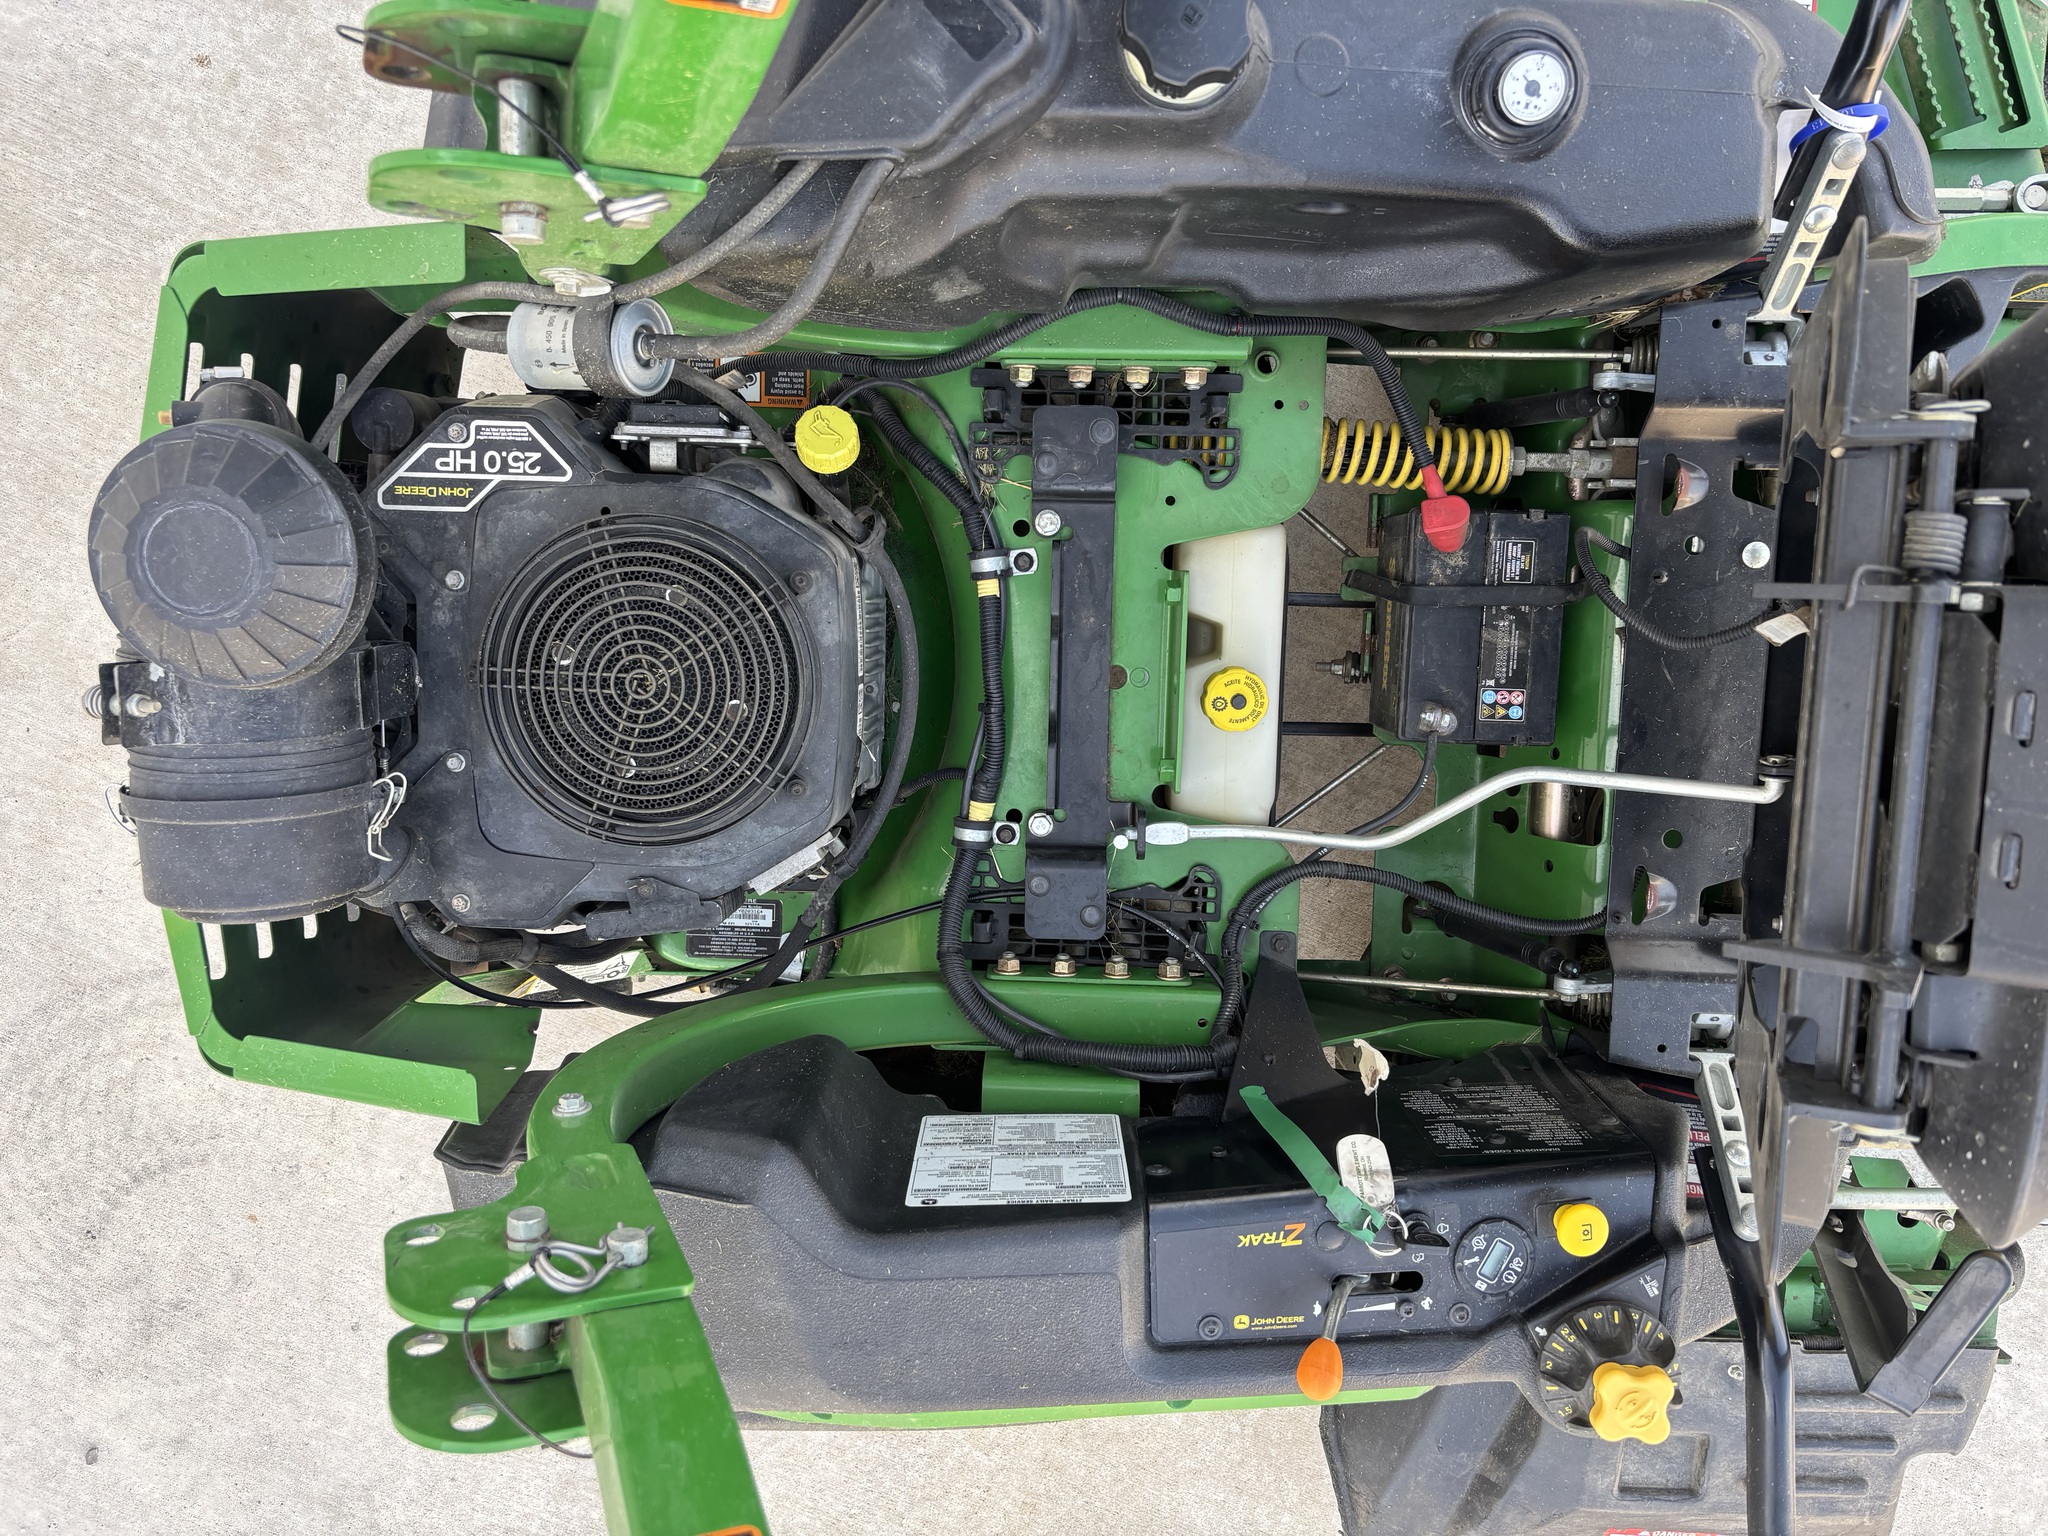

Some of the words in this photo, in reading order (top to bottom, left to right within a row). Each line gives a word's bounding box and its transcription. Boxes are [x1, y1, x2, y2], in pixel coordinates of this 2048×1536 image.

[435, 450, 477, 472] HP
[483, 450, 542, 474] 25.0
[394, 485, 437, 498] DEERE
[437, 486, 474, 498] JOHN
[1224, 679, 1241, 688] ACEITE
[1245, 675, 1265, 700] HYDRAULIC
[1228, 708, 1257, 724] SOLAMENTE
[1252, 710, 1262, 723] ONLY
[1352, 1149, 1364, 1177] IMPLEMENT
[1356, 1176, 1366, 1199] PARROTT
[1237, 1222, 1306, 1248] ZTRAK
[1251, 1317, 1275, 1325] JOHN
[1276, 1316, 1305, 1324] DEERE
[1593, 1311, 1603, 1319] 3
[1560, 1327, 1577, 1342] 2.5
[1546, 1361, 1553, 1370] 2
[1557, 1406, 1573, 1417] 1.5
